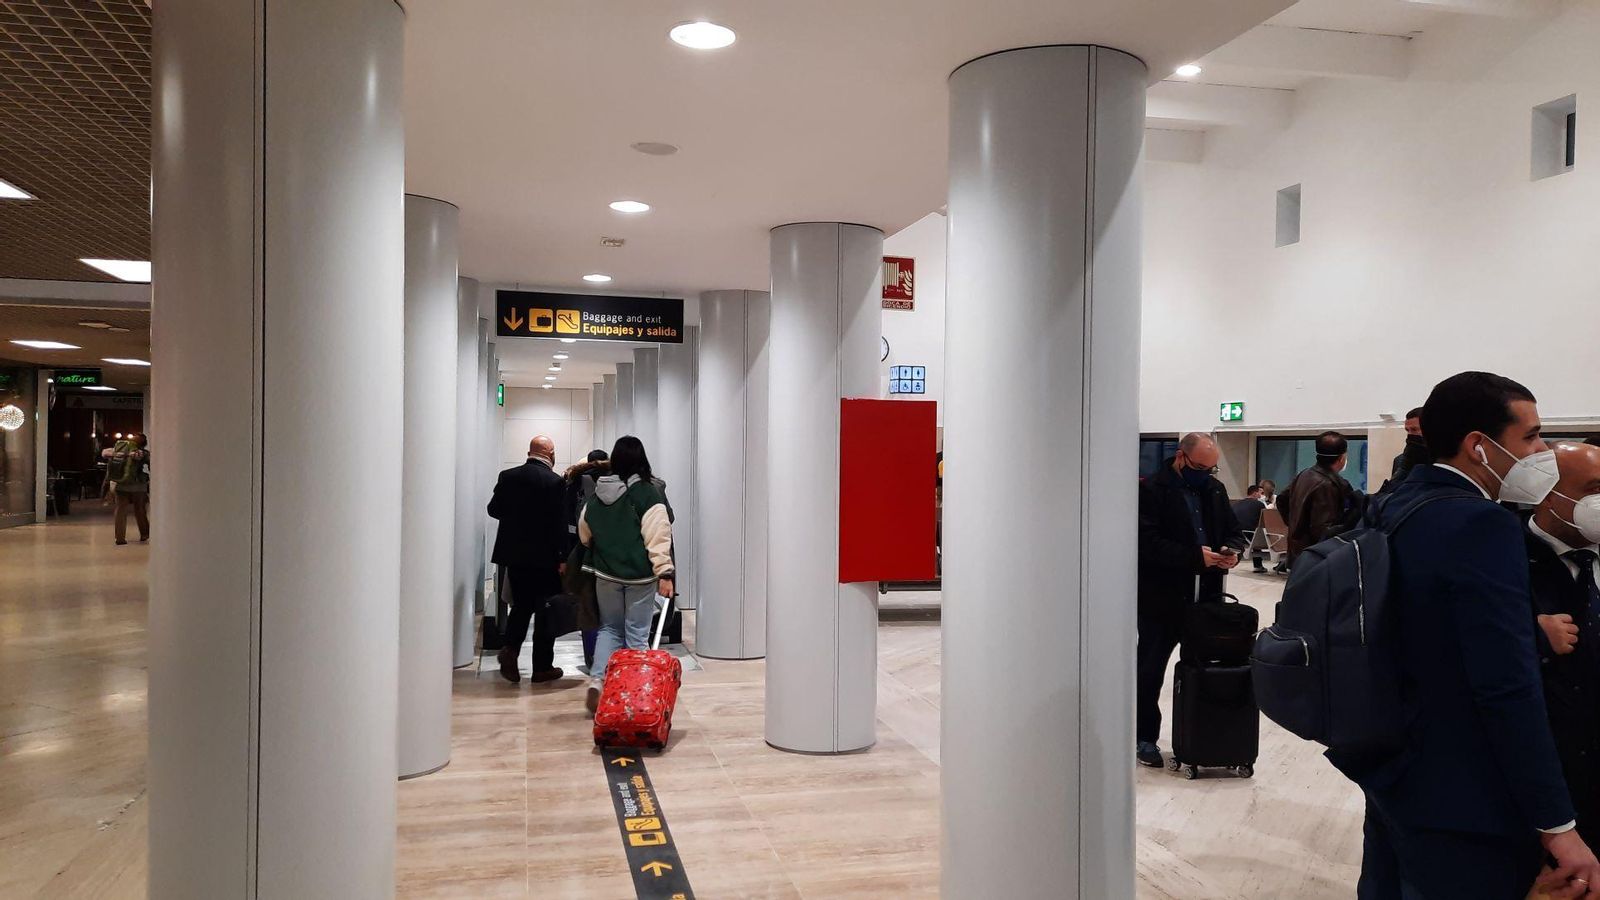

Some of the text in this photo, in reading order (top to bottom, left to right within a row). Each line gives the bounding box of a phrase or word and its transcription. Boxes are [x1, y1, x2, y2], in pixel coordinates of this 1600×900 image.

[582, 311, 662, 324] Baggage and exit
[582, 323, 677, 337] Equipajes y salida
[56, 374, 97, 383] natura
